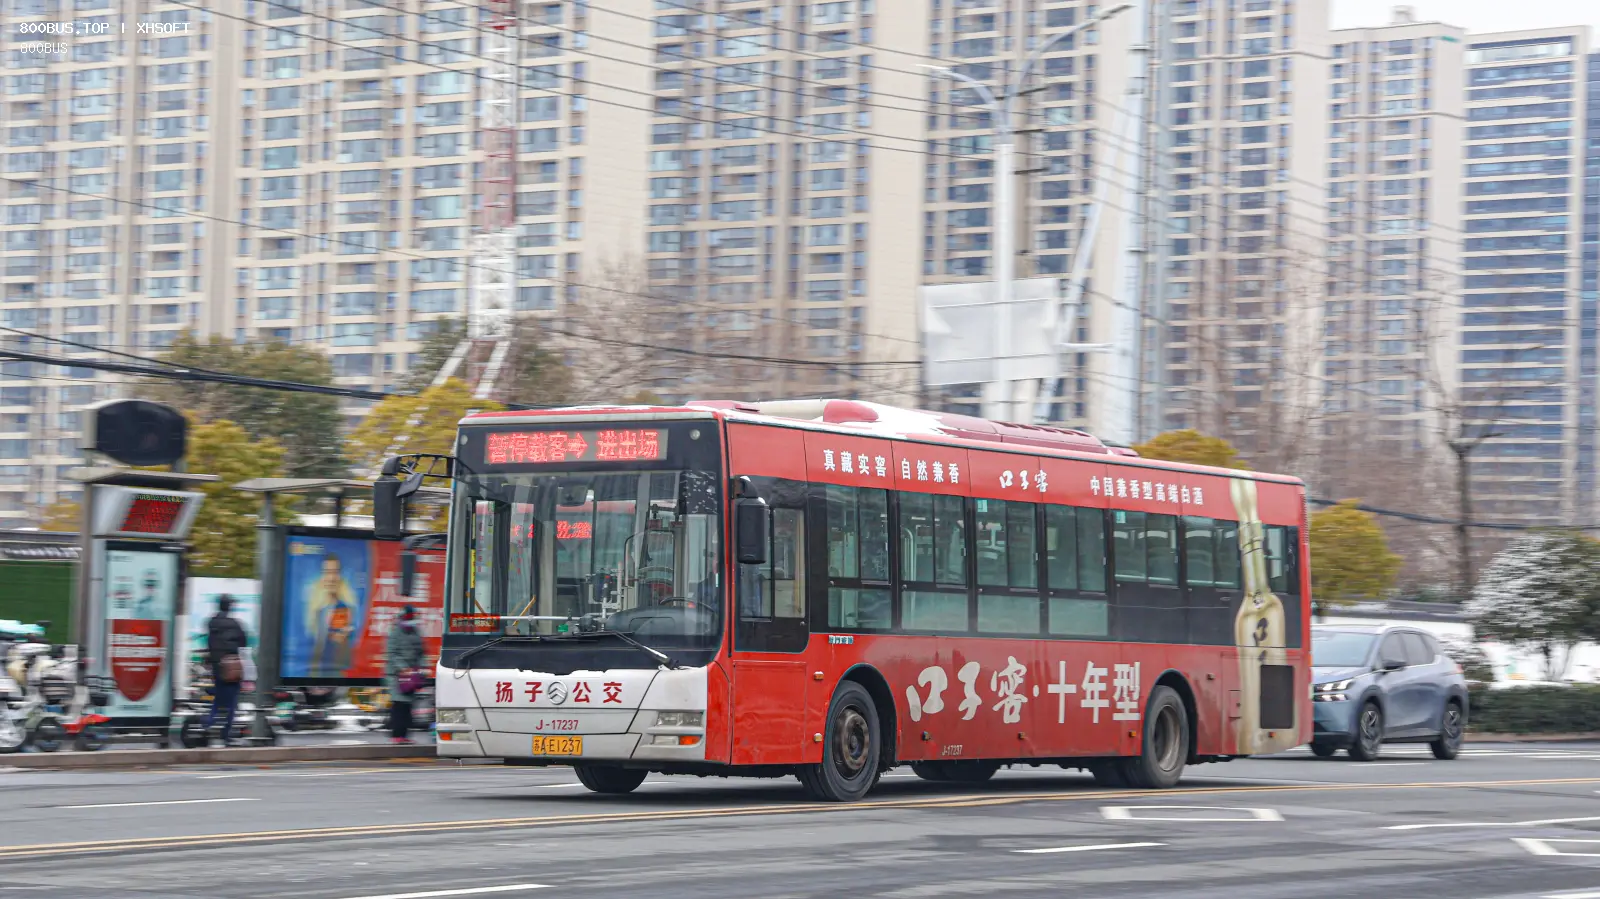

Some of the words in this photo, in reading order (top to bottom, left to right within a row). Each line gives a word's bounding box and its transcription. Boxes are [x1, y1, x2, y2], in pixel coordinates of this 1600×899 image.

[488, 432, 567, 463] 暂停载客
[596, 429, 659, 460] 进出场
[823, 449, 887, 478] 真藏实窖
[901, 458, 959, 484] 自然兼香
[999, 469, 1048, 493] 口子窖
[1089, 475, 1204, 506] 中国兼香型高端白酒
[535, 719, 579, 731] J-17237
[941, 744, 964, 757] J-17237
